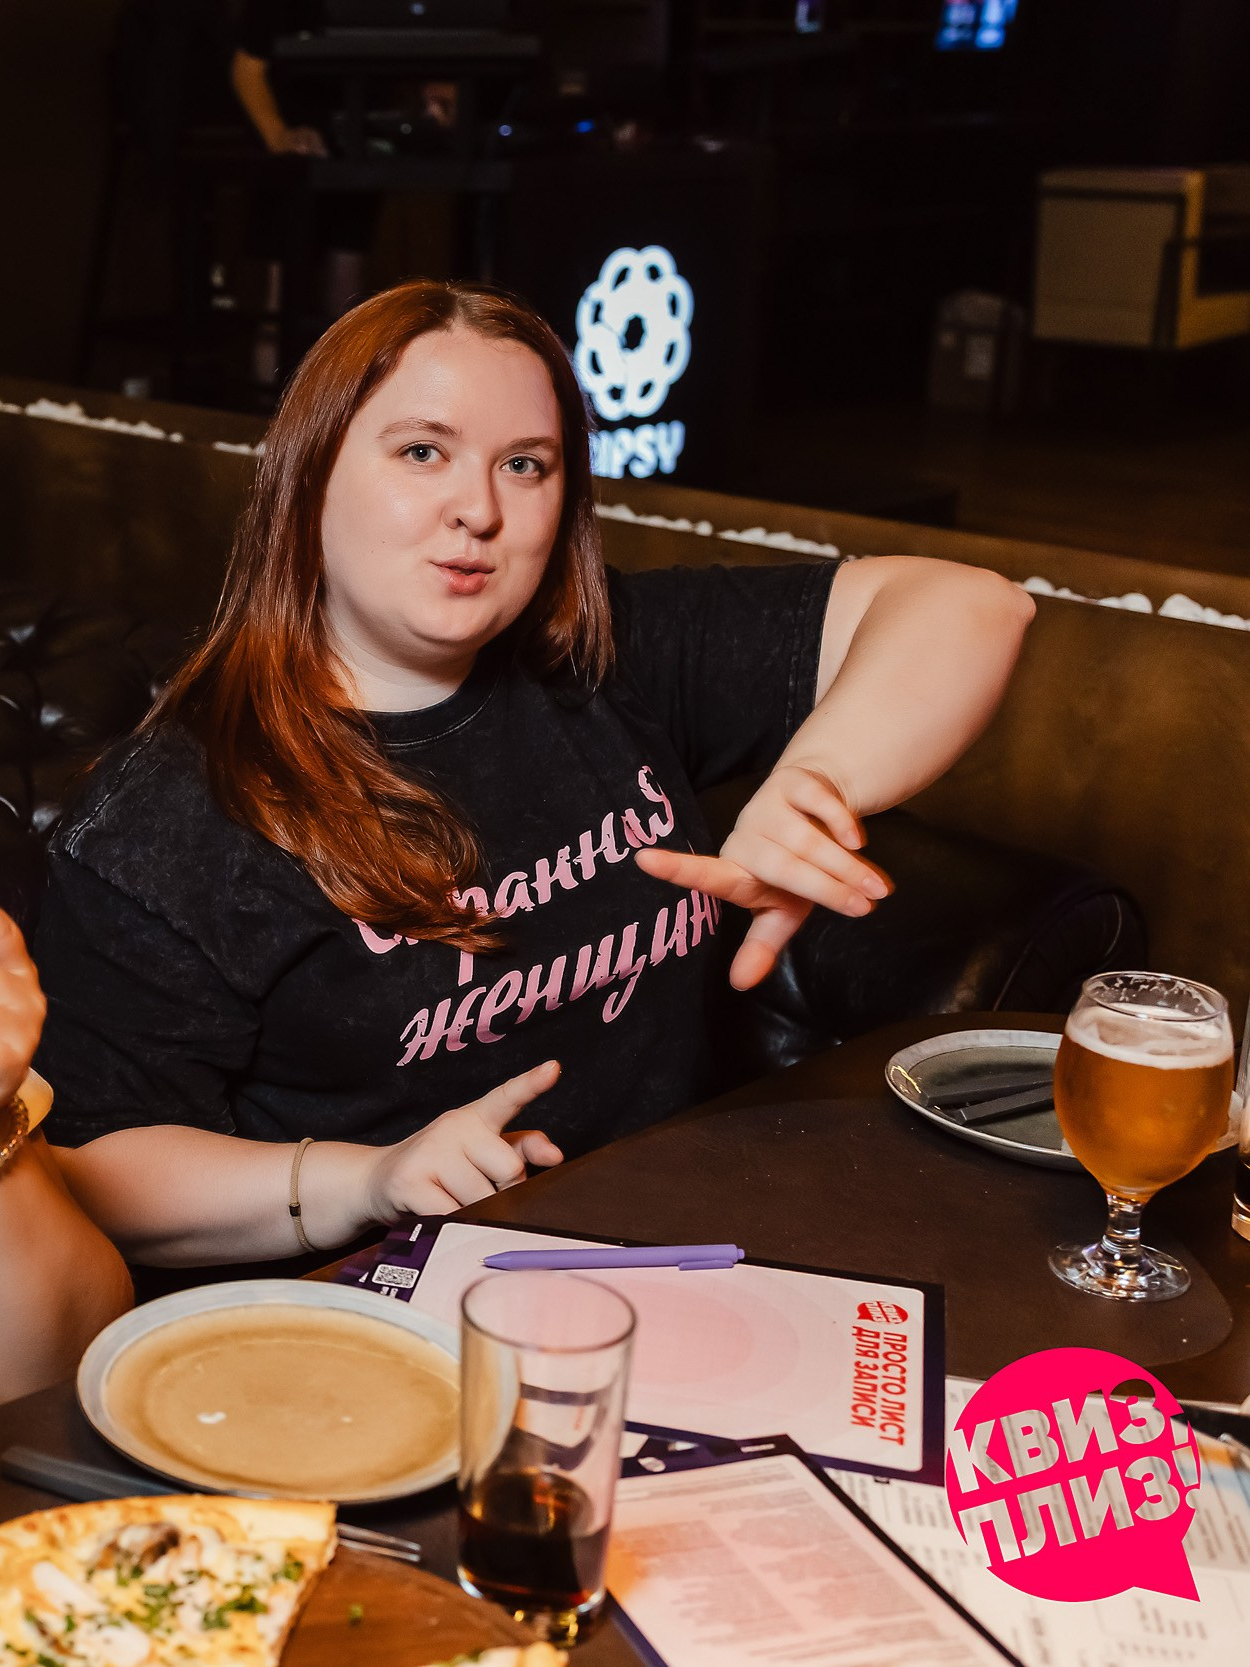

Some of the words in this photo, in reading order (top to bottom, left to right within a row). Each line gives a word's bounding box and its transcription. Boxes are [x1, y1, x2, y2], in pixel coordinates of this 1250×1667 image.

[396, 889, 720, 1066] женщин
[853, 1326, 881, 1359] ДЛЯ
[881, 1332, 907, 1395] ПРОСТО
[851, 1361, 879, 1427] ЗАПИСИ
[879, 1398, 905, 1446] ЛИСТ
